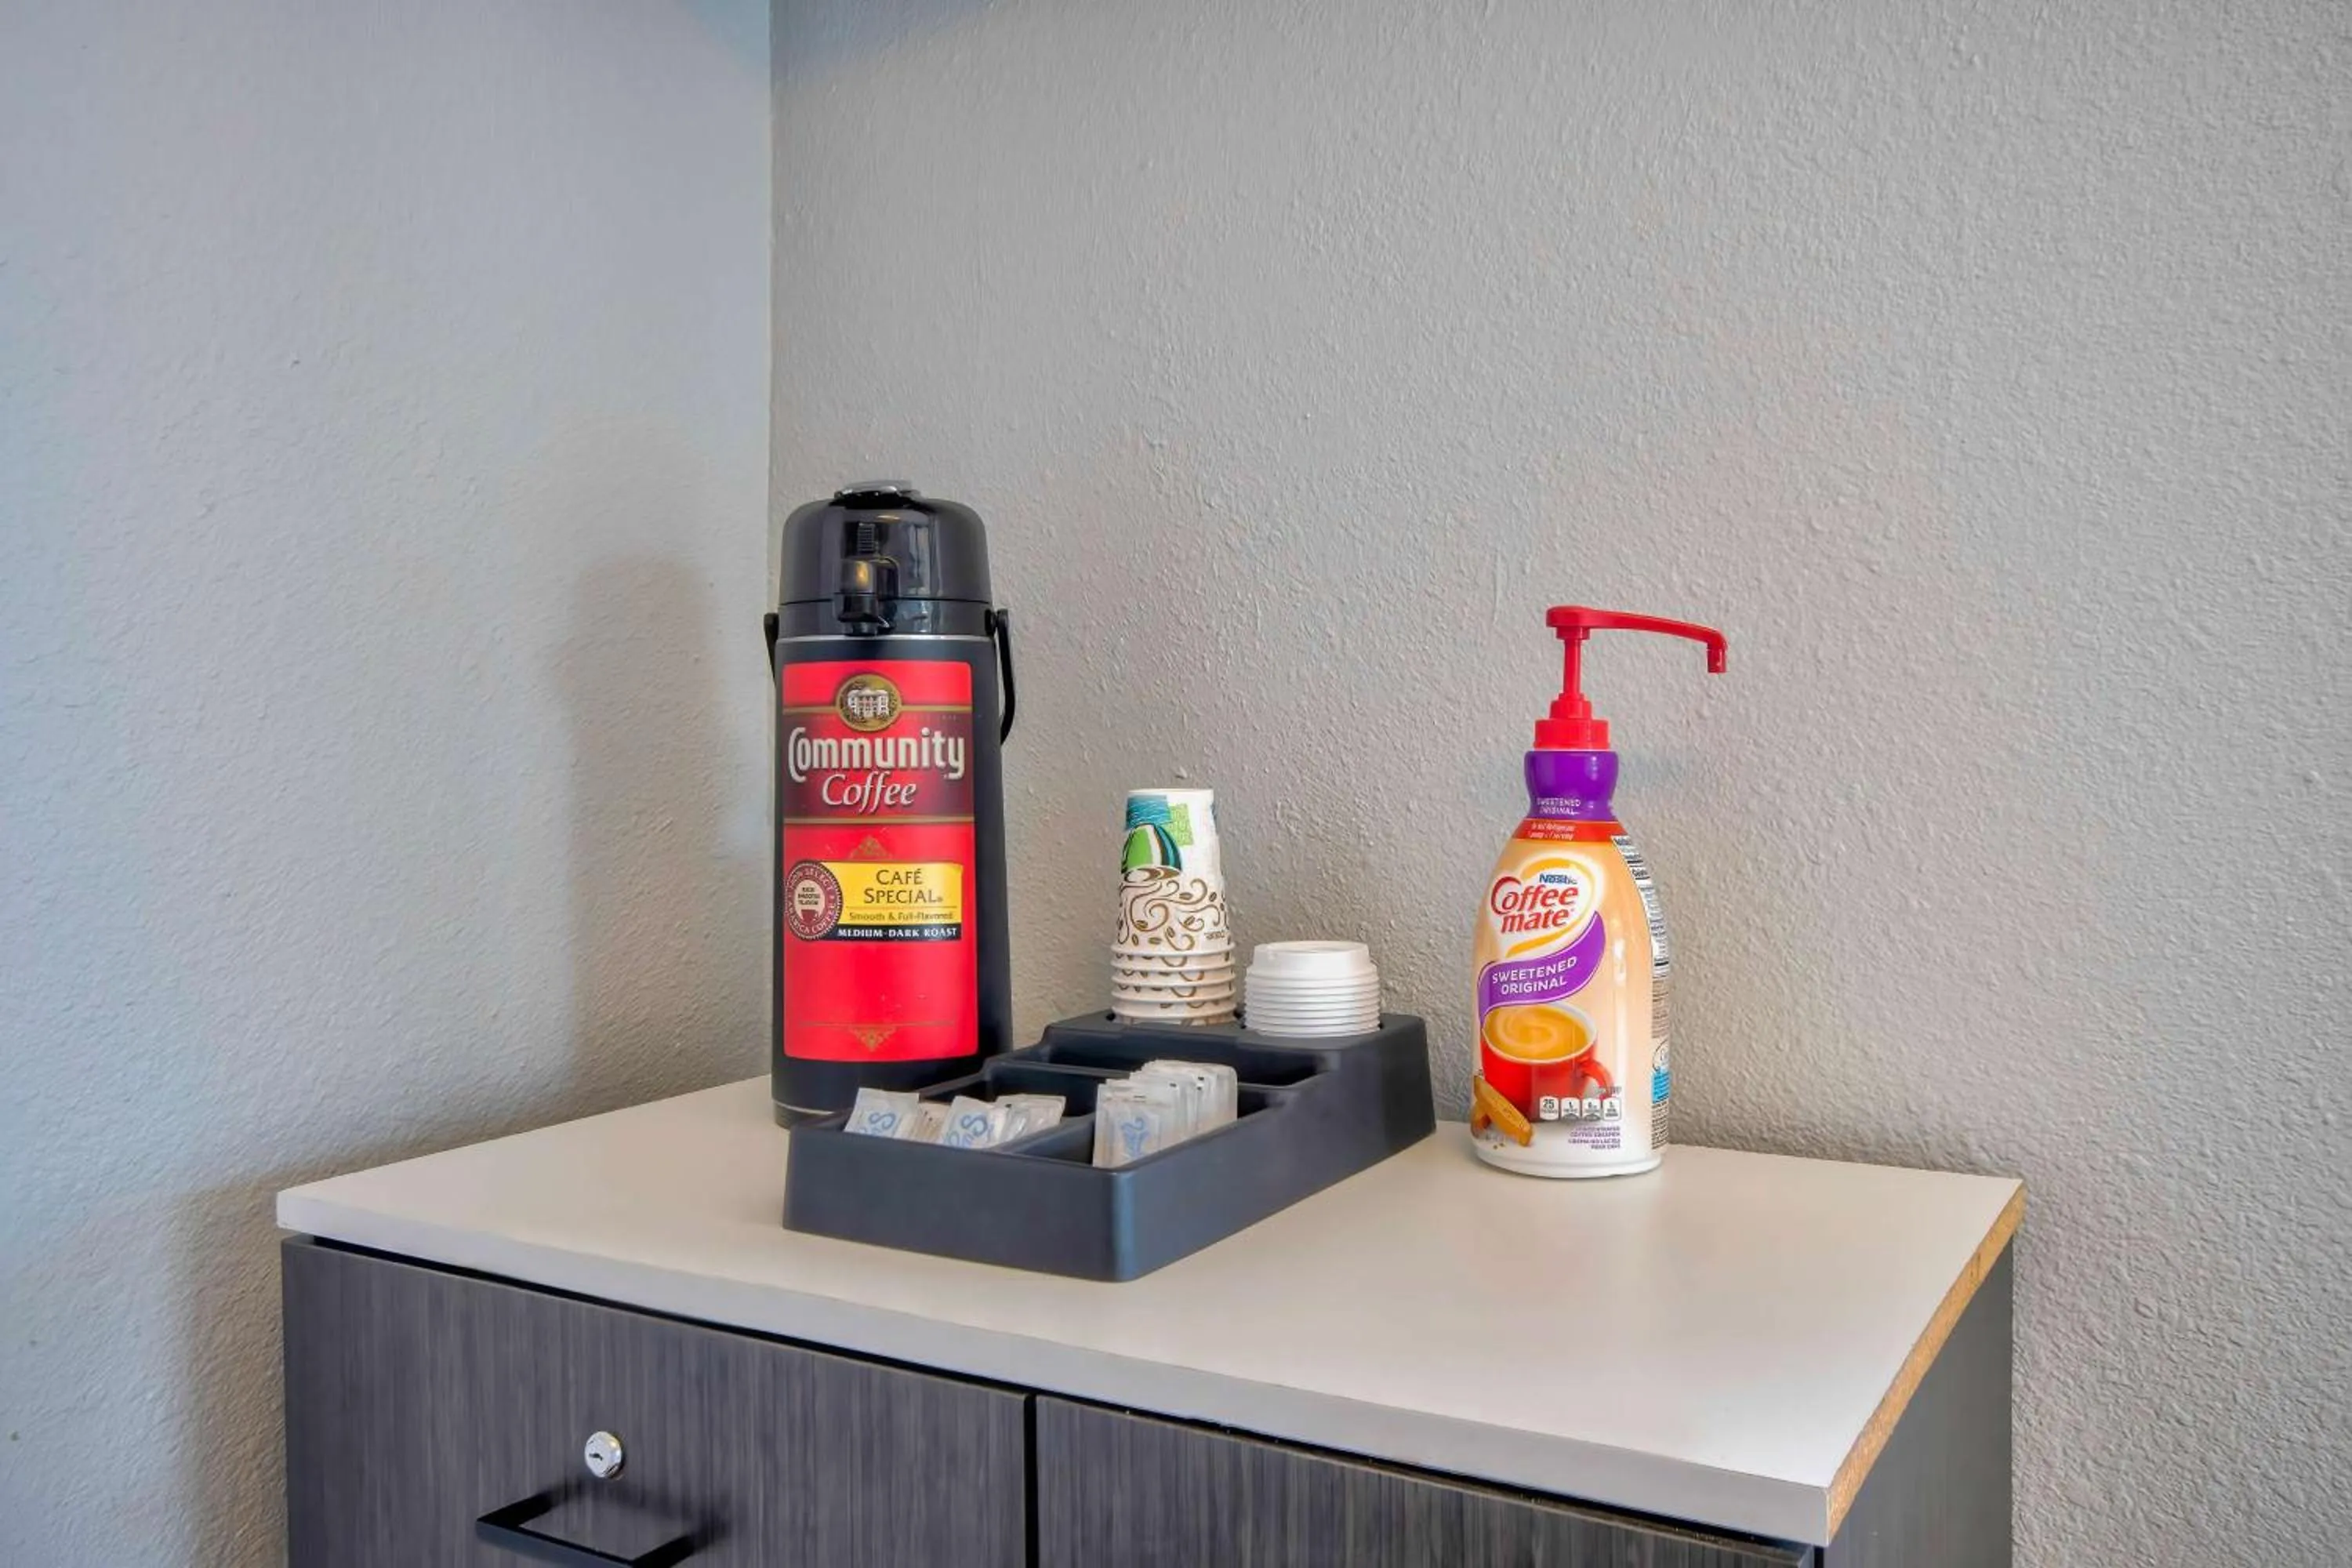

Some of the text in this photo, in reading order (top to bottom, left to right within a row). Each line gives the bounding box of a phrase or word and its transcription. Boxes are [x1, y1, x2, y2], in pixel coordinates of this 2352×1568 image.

[788, 727, 965, 782] Community
[822, 771, 916, 813] Coffee
[876, 869, 924, 885] CAFÉ
[863, 887, 938, 904] SPECIAL
[1491, 876, 1579, 915] Coffee
[849, 911, 886, 921] Smooth
[888, 912, 898, 920] &
[1501, 909, 1570, 934] mate
[924, 927, 957, 938] ROAST
[1492, 956, 1577, 984] SWEETENED
[1501, 975, 1567, 995] ORIGINAL
